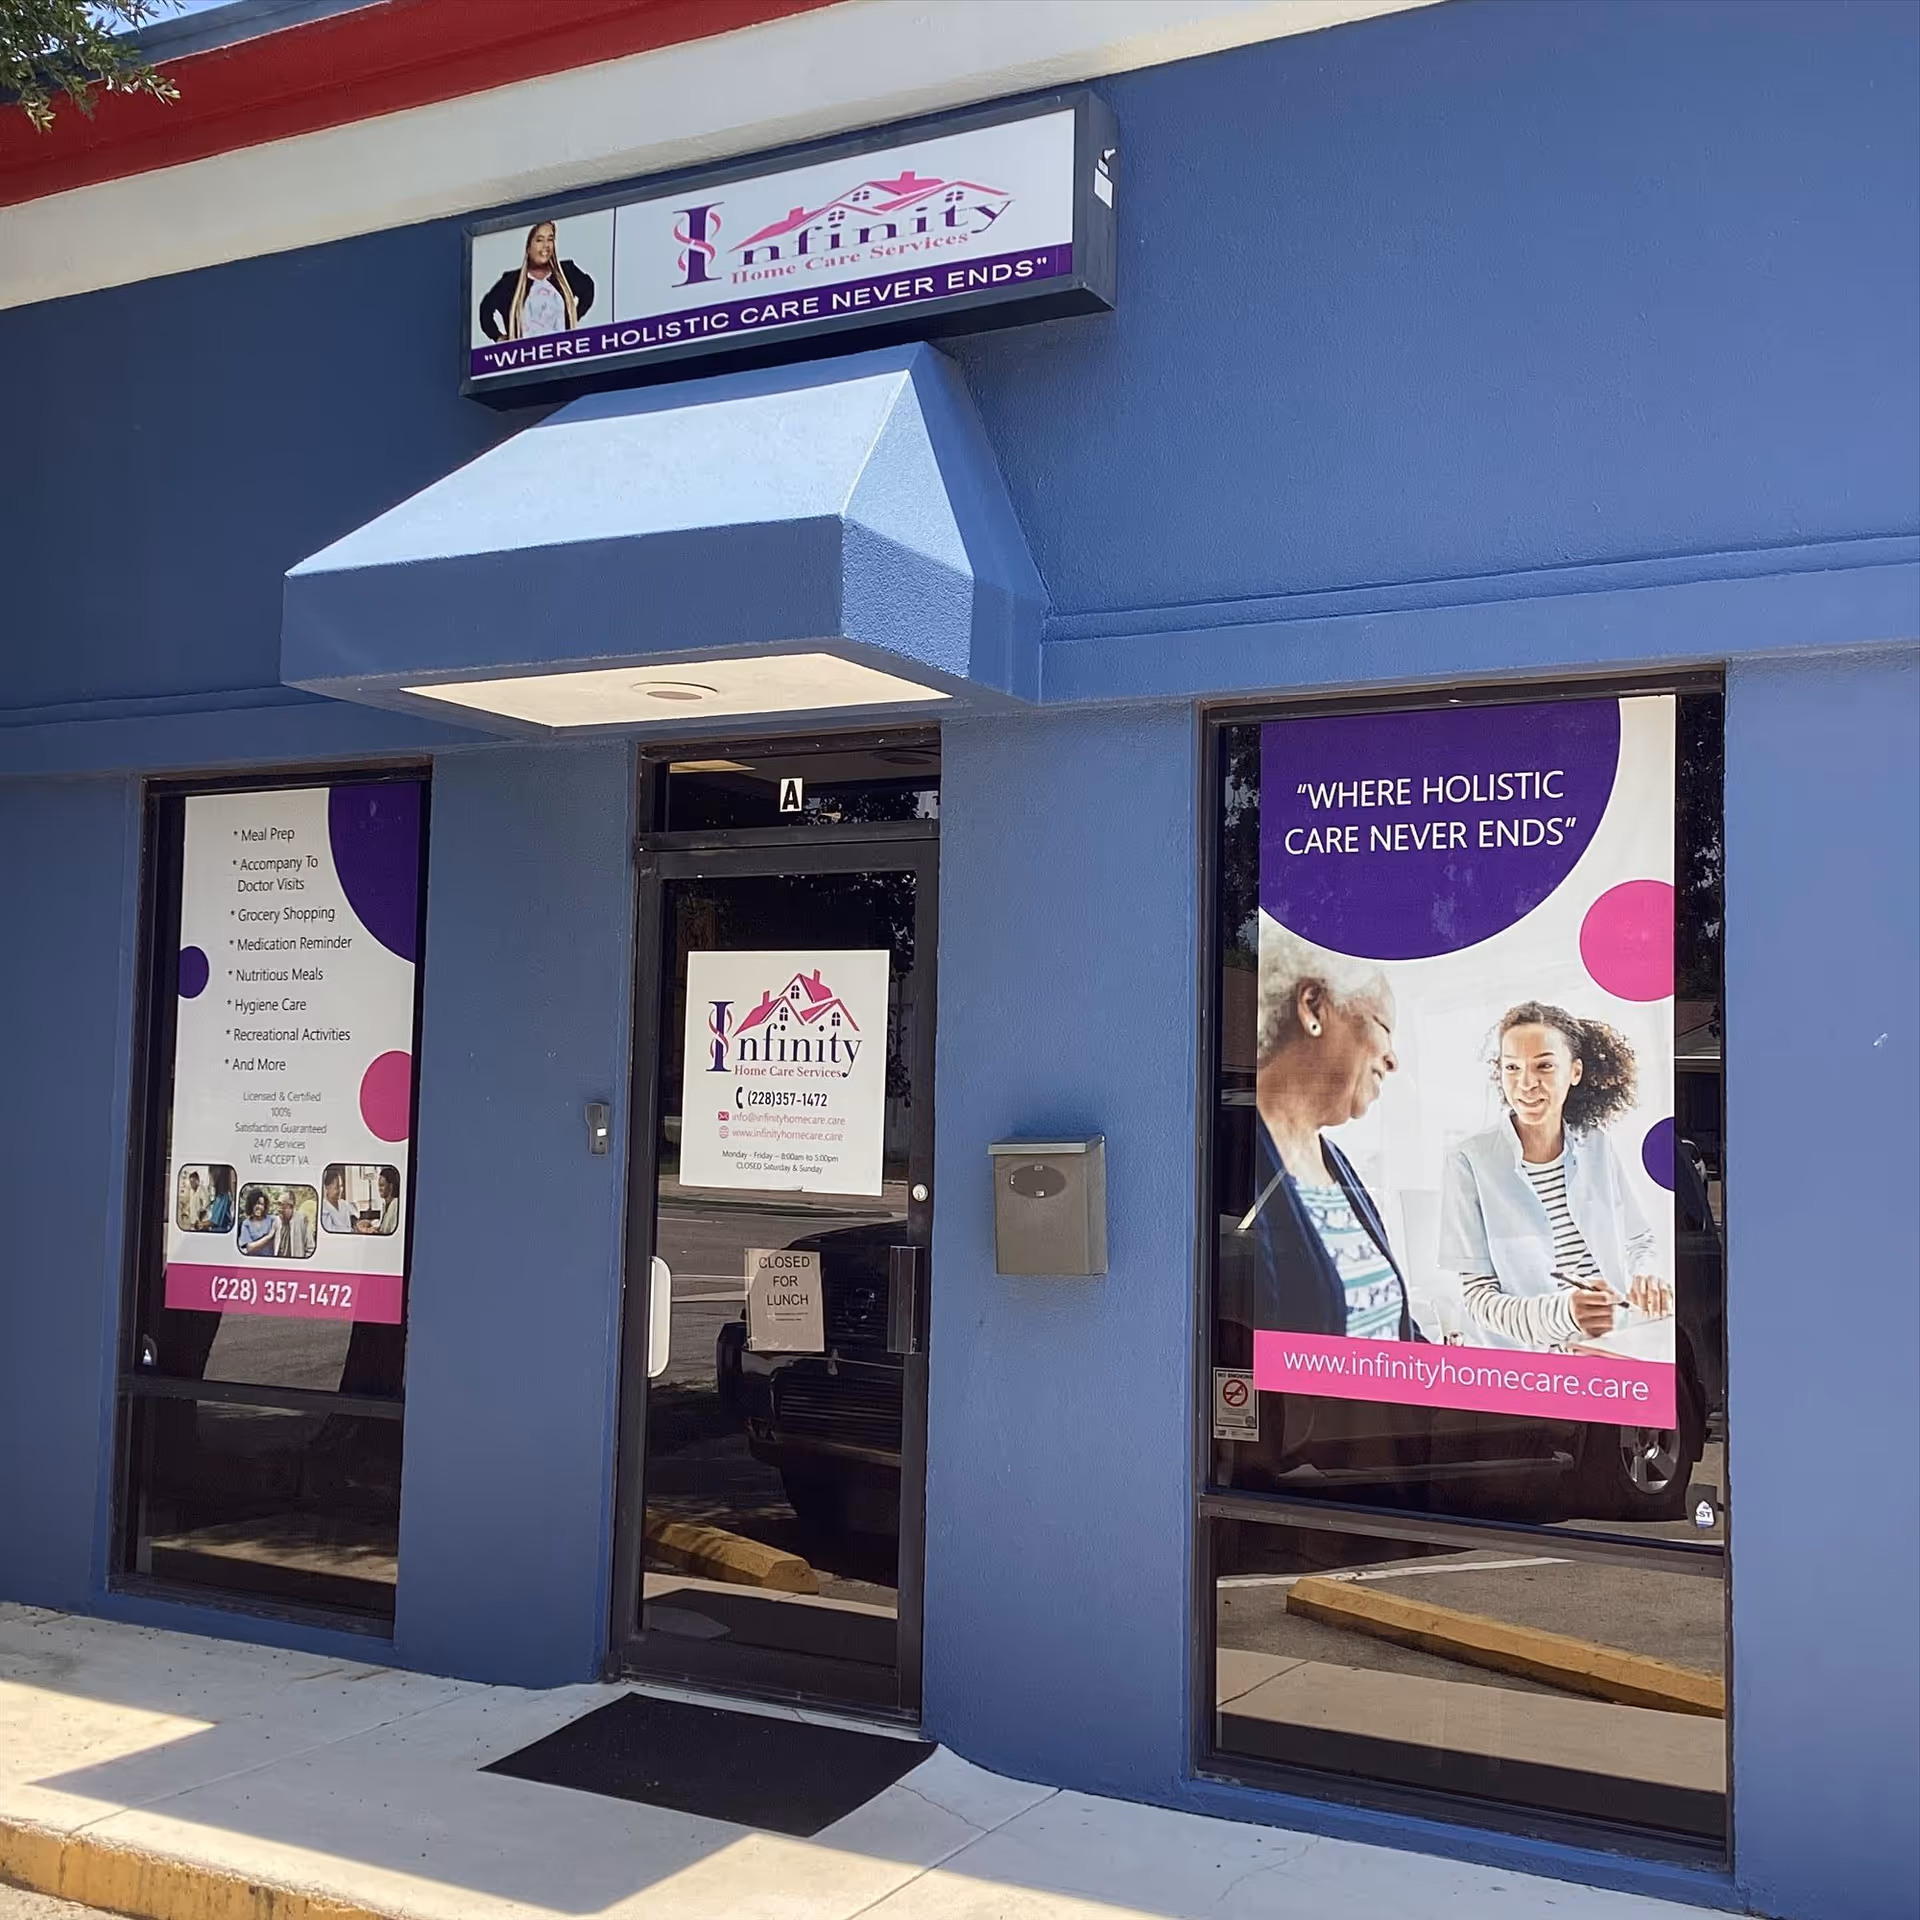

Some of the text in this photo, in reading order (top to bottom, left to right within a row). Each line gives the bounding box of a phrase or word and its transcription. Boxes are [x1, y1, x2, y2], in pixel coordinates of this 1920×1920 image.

[671, 199, 1016, 288] Infinity
[730, 231, 969, 285] Home Care Services
[484, 256, 1049, 369] "WHERE HOLISTIC CARE NEVER ENDS"
[1422, 770, 1565, 805] HOLISTIC
[782, 780, 800, 810] A
[241, 828, 295, 843] Meal Prep
[1284, 825, 1359, 856] CARE
[1370, 821, 1467, 853] NEVER
[240, 855, 318, 873] Accompany To
[237, 878, 305, 892] Doctor Visits
[238, 906, 335, 924] Grocery Shopping
[237, 936, 352, 951] Medication Reminder
[236, 967, 323, 982] Nutritious Meals
[235, 998, 306, 1015] Hygiene Care
[233, 1028, 351, 1041] Recreational Activities
[706, 1000, 863, 1078] Infinity
[232, 1058, 286, 1071] And More
[734, 1065, 842, 1078] Home Care Services
[243, 1091, 321, 1102] Licensed & Certified
[748, 1091, 828, 1107] (228)357-1472
[271, 1107, 291, 1117] 100%
[732, 1112, 846, 1126] info@infinityhomecare.care
[235, 1122, 327, 1134] Satisfaction Guaranteed
[732, 1129, 844, 1142] www.infinityhomecare.care
[253, 1138, 305, 1149] 24/7 Services
[249, 1154, 310, 1165] WE ACCEPT VA
[722, 1150, 748, 1160] Monday
[754, 1151, 773, 1162] Friday
[781, 1152, 804, 1161] 8:00am
[806, 1153, 813, 1161] to
[814, 1153, 839, 1163] 5:00pm
[736, 1162, 823, 1174] CLOSED Saturday & Sunday
[759, 1256, 810, 1269] CLOSED
[773, 1275, 798, 1287] FOR
[211, 1275, 352, 1308] (228) 357-1472
[766, 1294, 809, 1306] LUNCH
[1283, 1350, 1650, 1402] www.infinityhomecare.care
